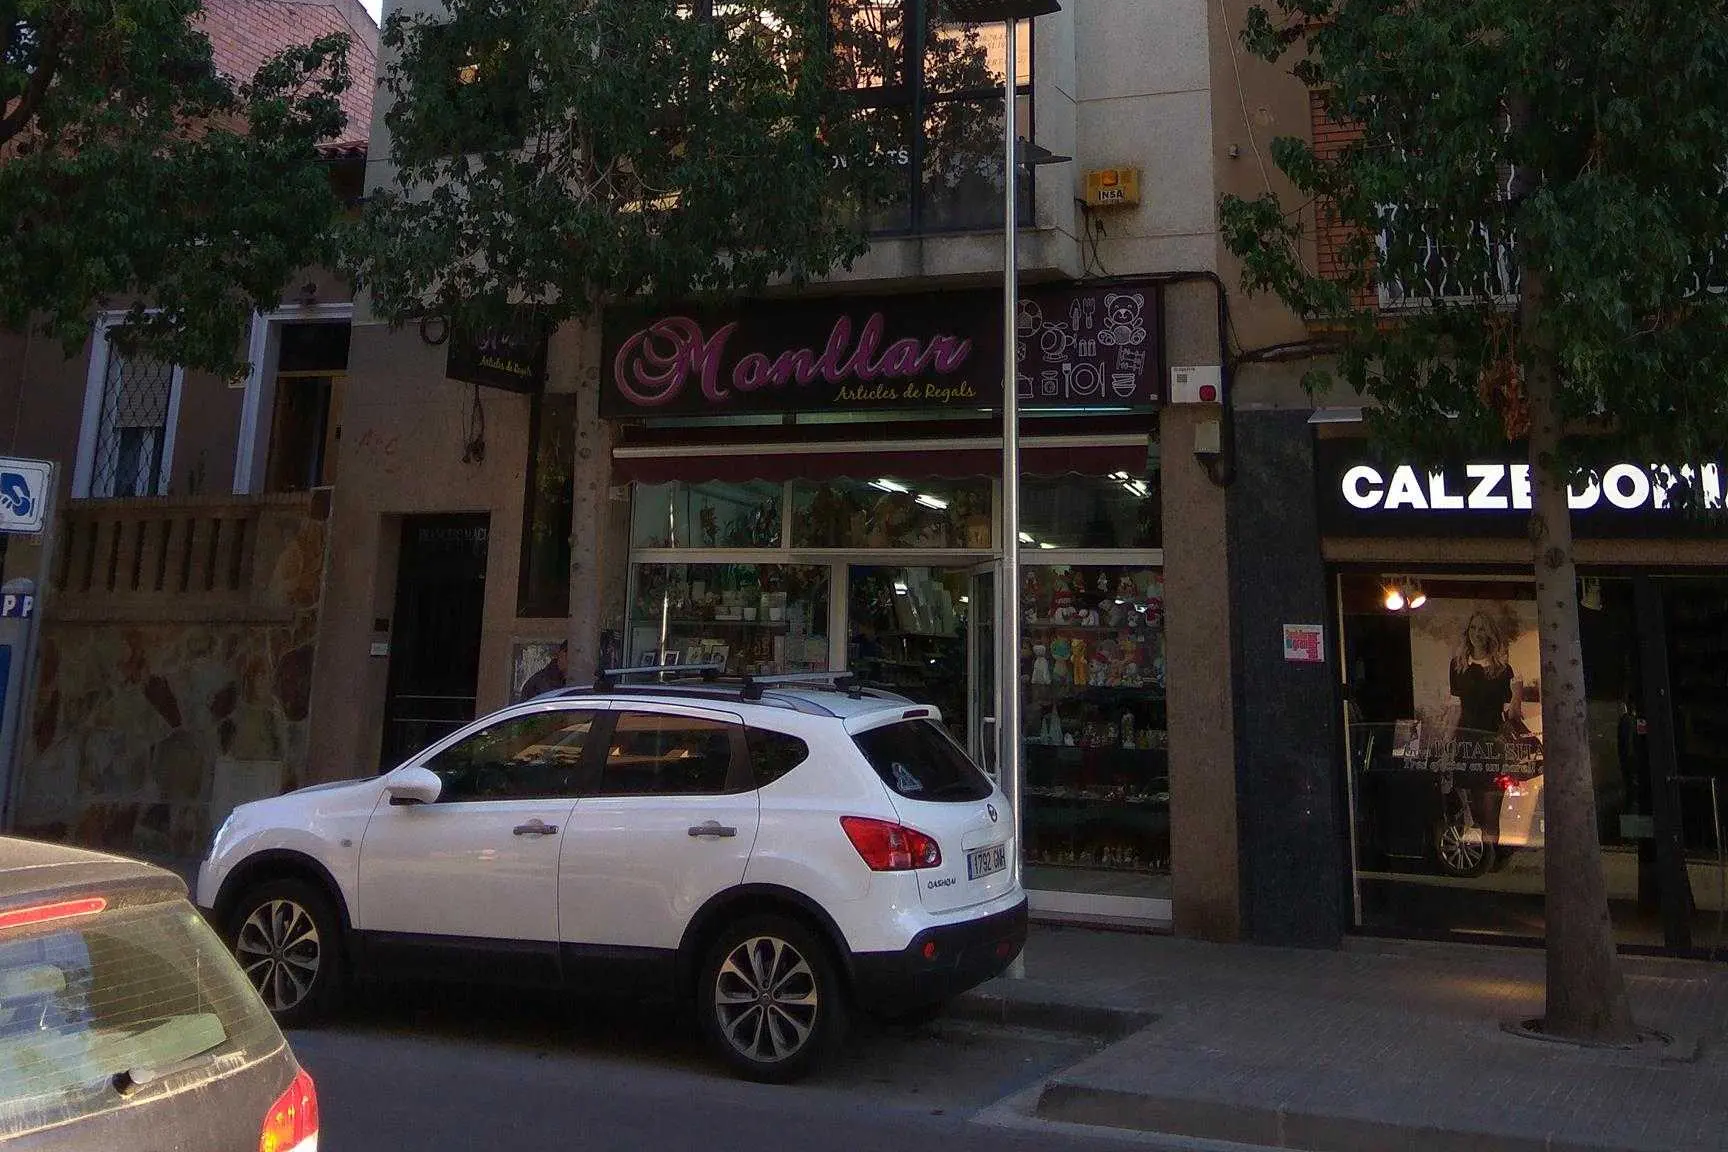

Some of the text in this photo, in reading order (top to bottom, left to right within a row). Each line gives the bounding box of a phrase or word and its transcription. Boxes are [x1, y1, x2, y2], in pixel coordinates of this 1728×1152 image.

[614, 312, 971, 405] Monllar
[833, 380, 977, 403] Articles de Regals
